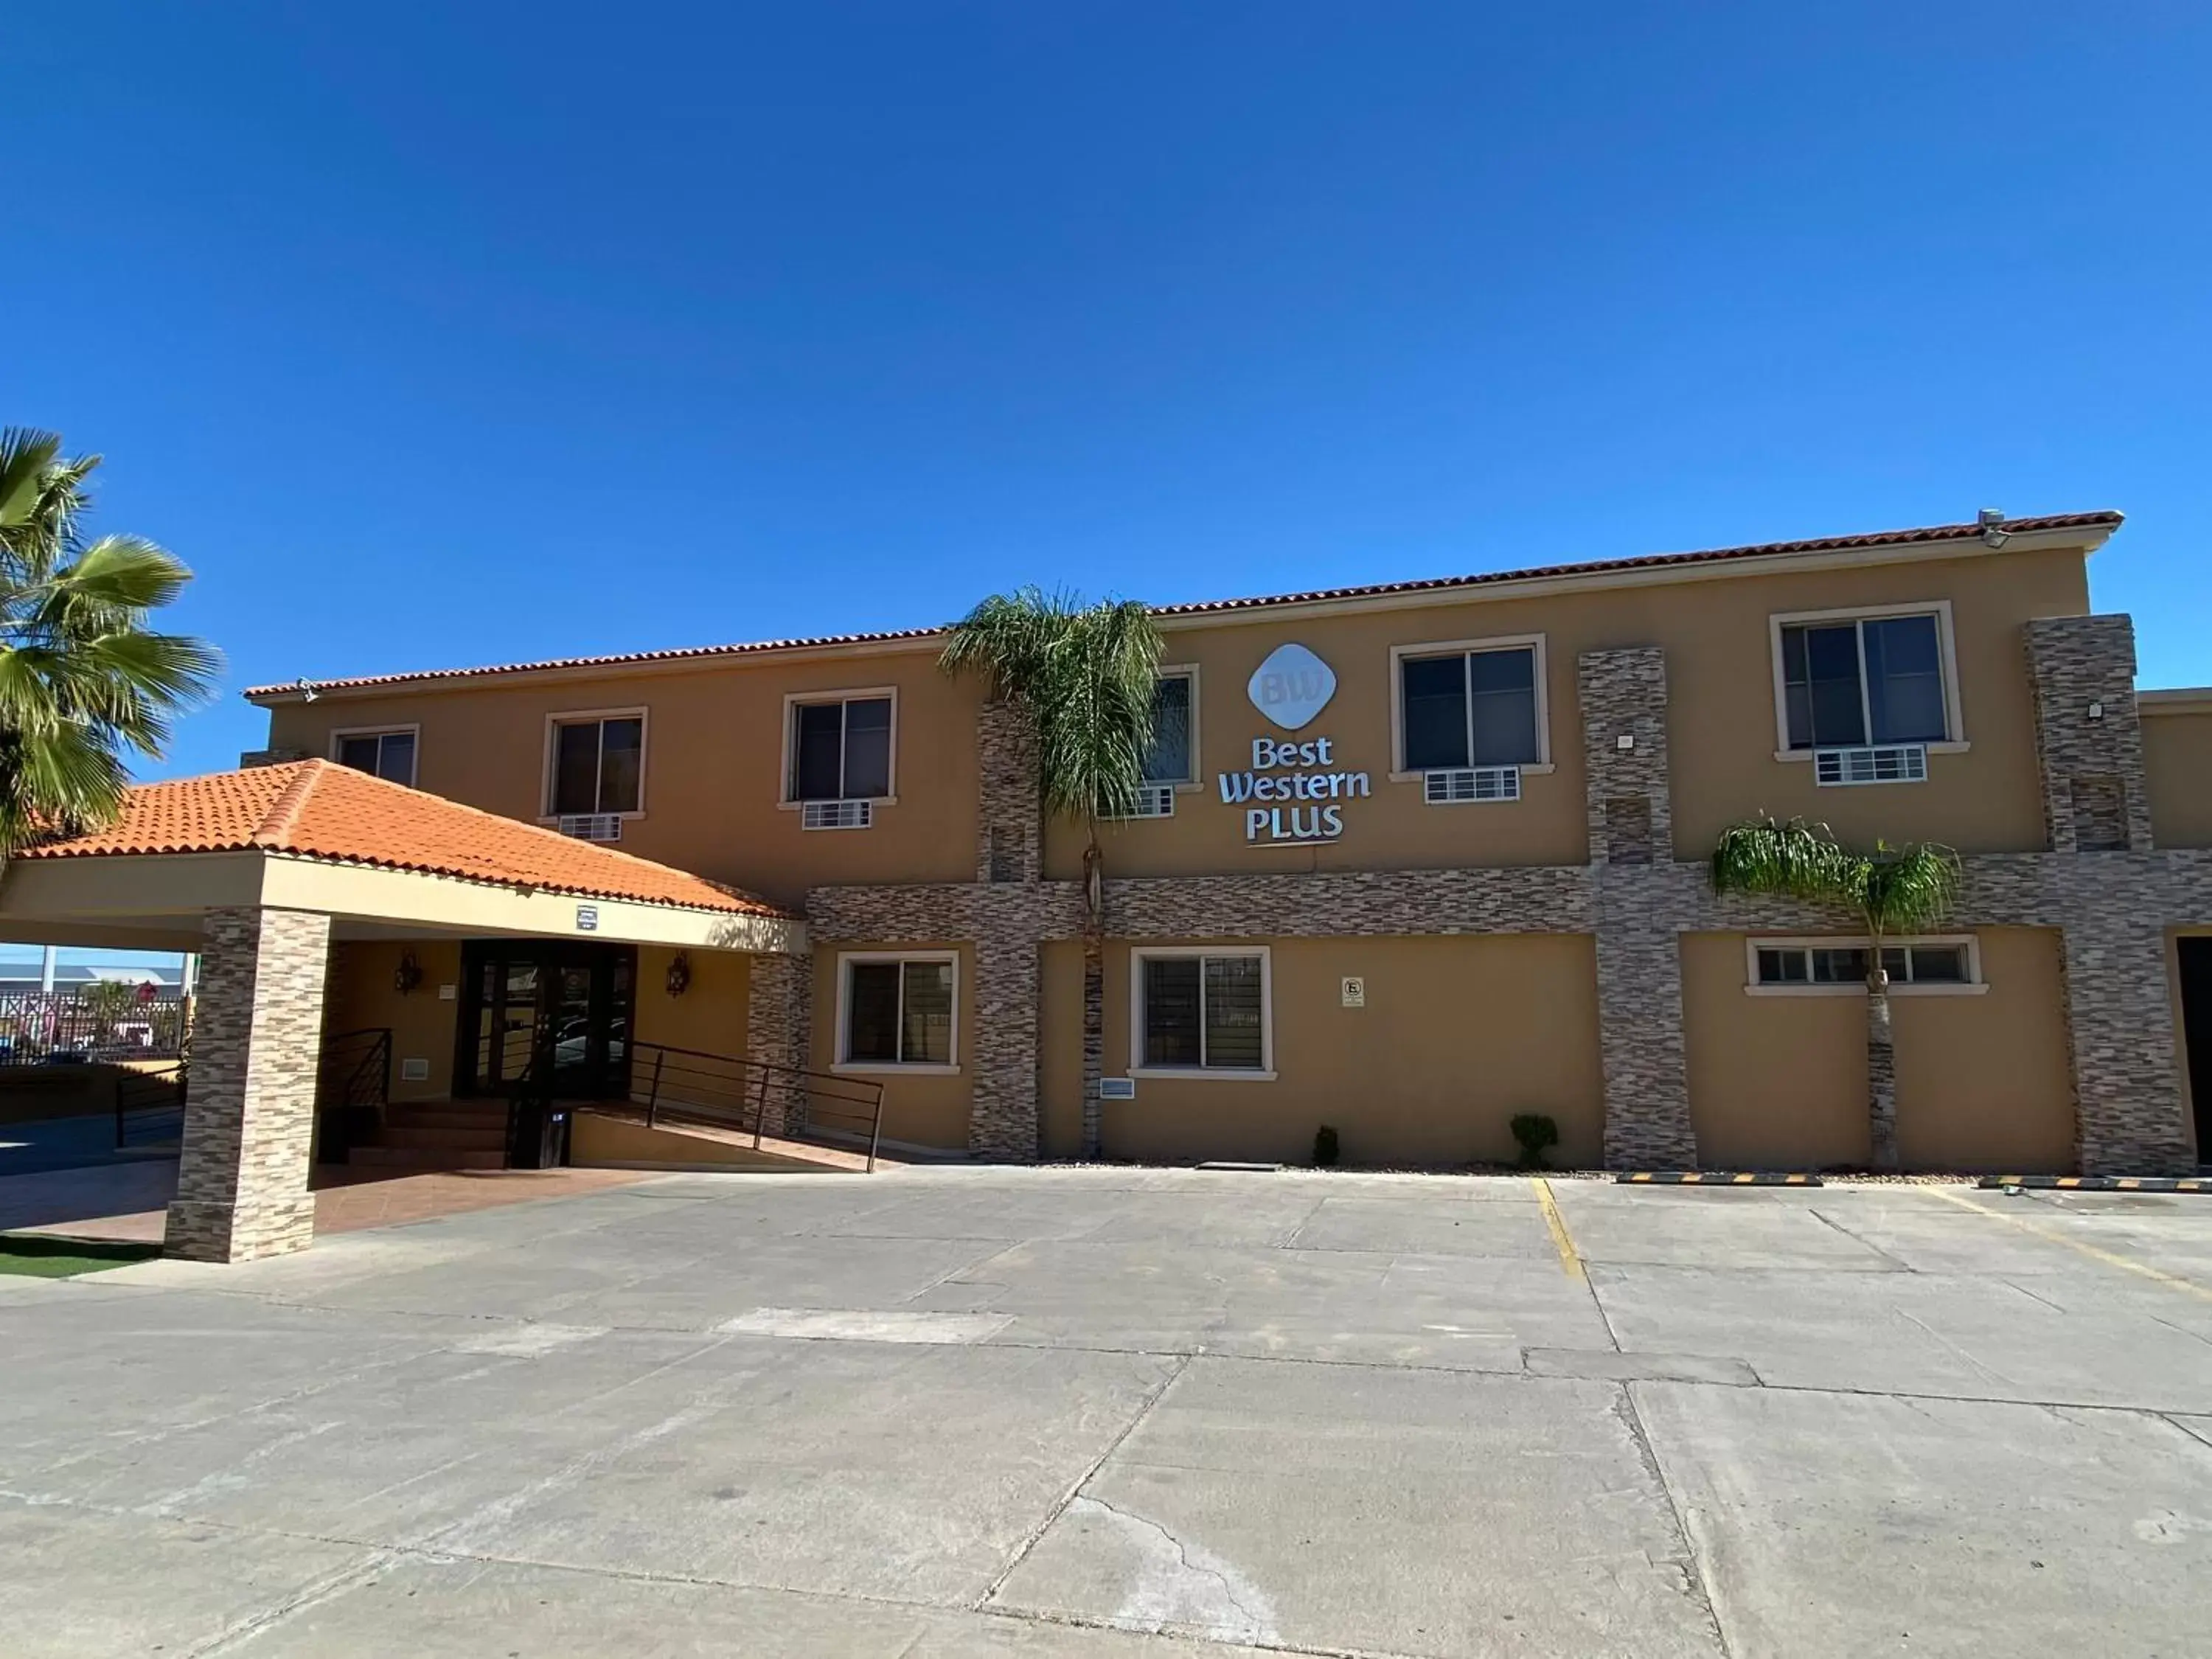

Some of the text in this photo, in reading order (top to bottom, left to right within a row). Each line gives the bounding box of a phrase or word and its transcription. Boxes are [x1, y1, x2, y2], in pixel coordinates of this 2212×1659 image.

[1260, 670, 1324, 706] BW
[1252, 737, 1334, 770] Best
[1217, 771, 1372, 804] Western
[1246, 804, 1343, 840] PLUS
